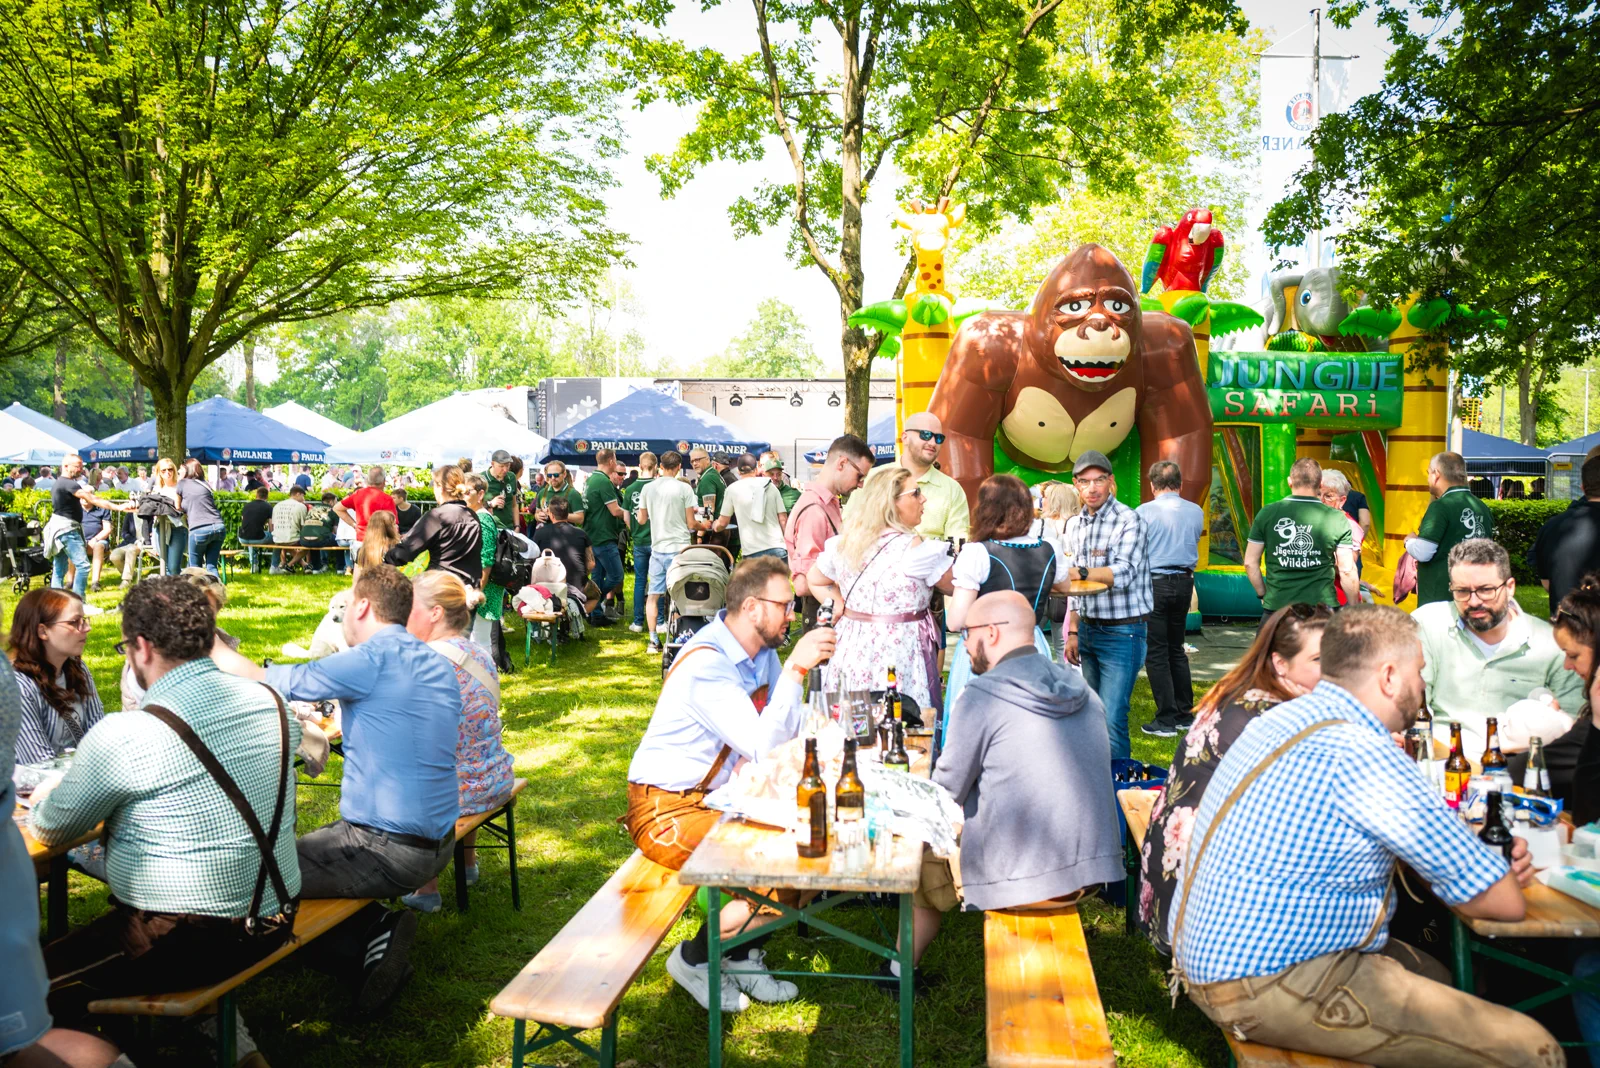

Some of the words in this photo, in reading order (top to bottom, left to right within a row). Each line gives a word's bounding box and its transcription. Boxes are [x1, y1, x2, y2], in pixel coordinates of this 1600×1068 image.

[1211, 359, 1398, 391] JUNGLE
[590, 441, 648, 451] PAULANER
[877, 445, 896, 455] PAUL
[98, 449, 131, 459] PAULANER
[233, 450, 273, 460] PAULANER
[301, 452, 324, 462] PAULA
